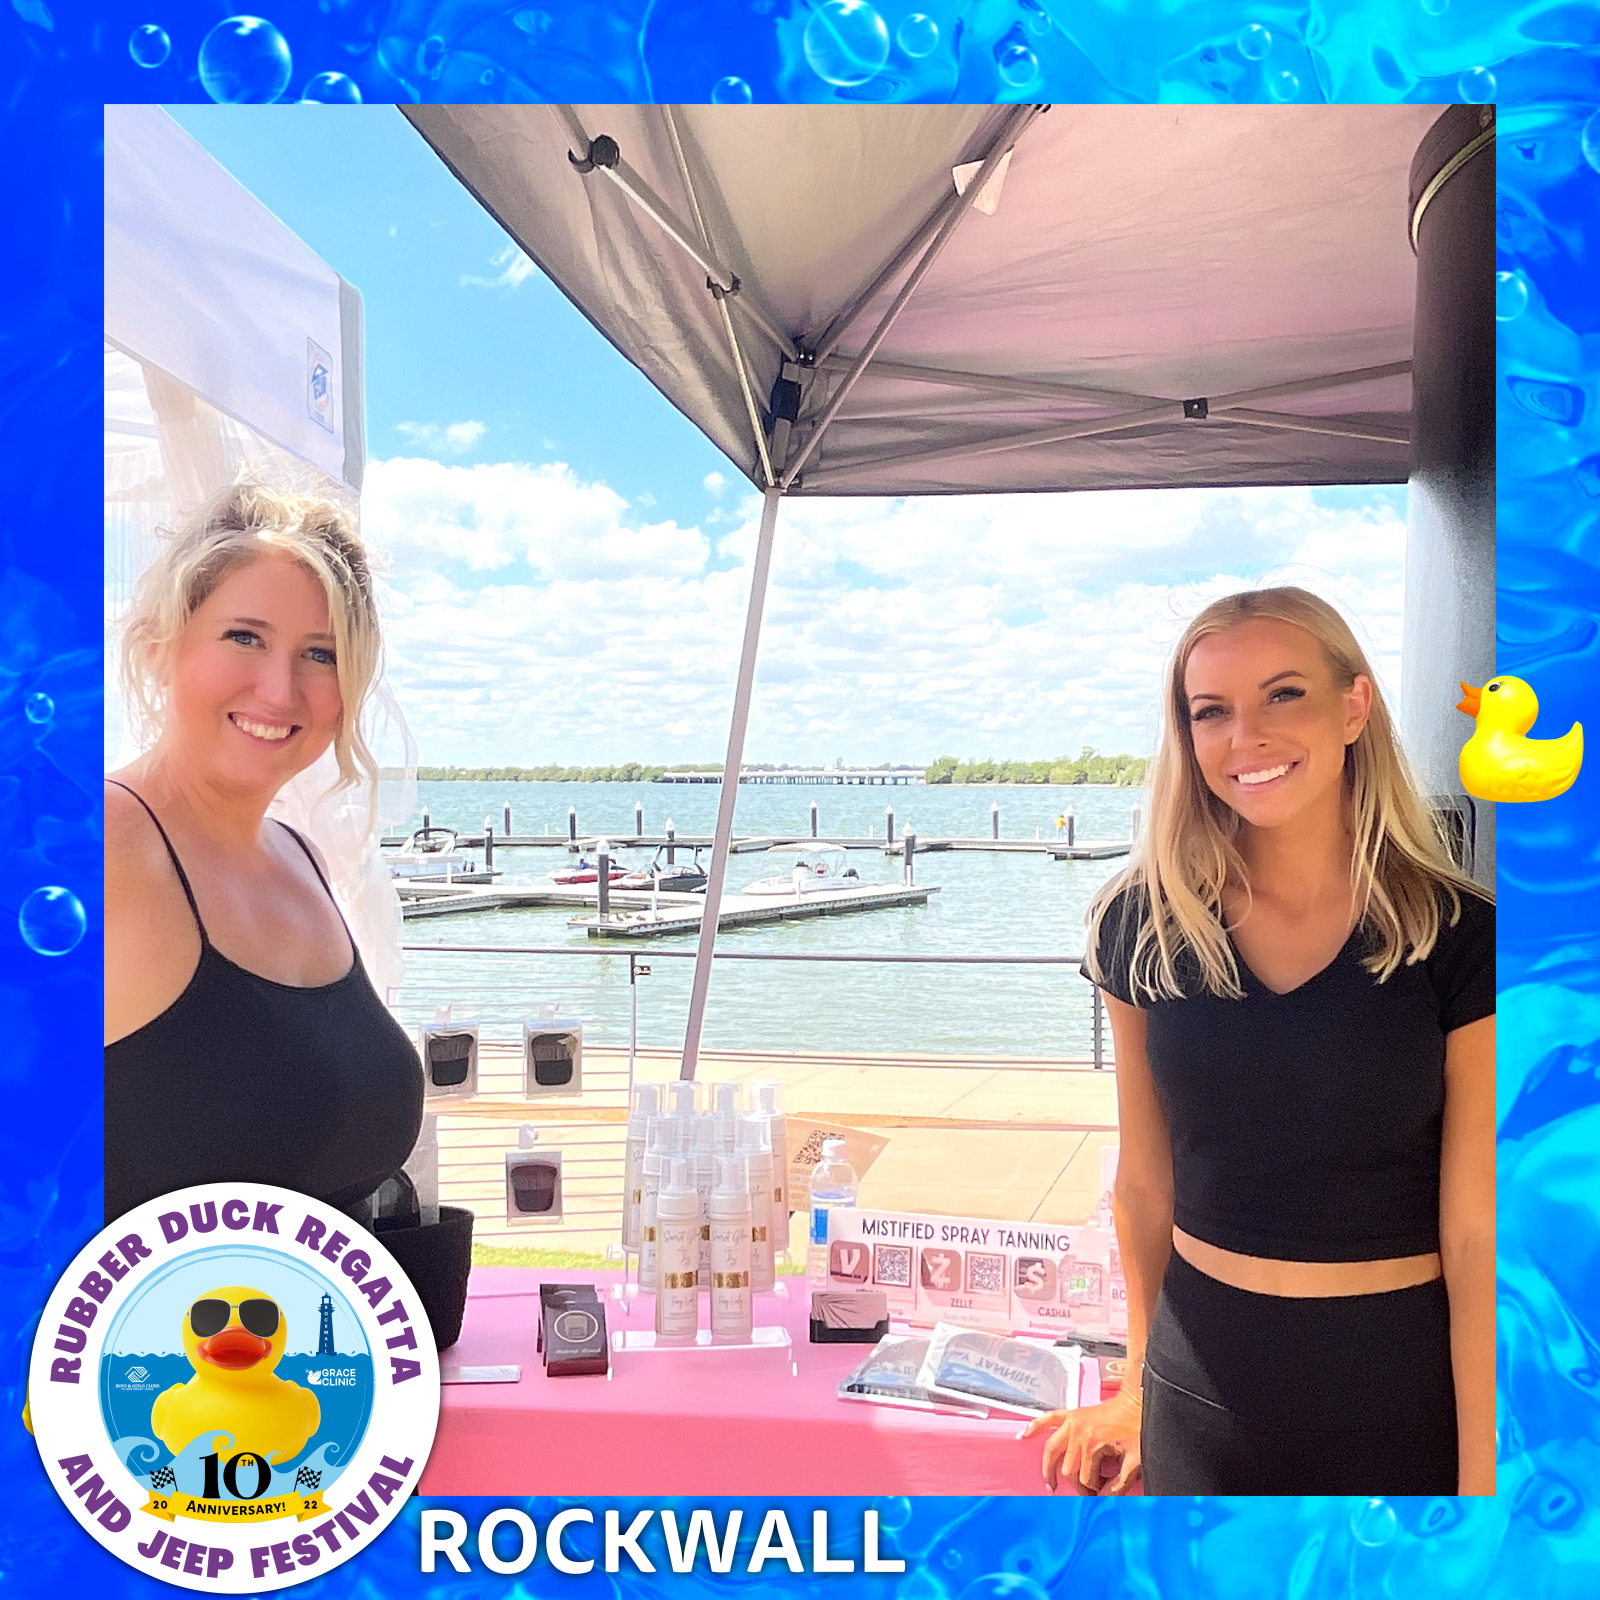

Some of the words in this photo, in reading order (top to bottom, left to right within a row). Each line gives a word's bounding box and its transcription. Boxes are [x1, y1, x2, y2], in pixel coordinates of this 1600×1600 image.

[862, 1218, 935, 1239] MISTIFIED
[941, 1225, 990, 1245] SPRAY
[997, 1229, 1070, 1251] TANNING
[950, 1298, 973, 1309] ZELLE
[943, 1312, 959, 1321] Scan
[960, 1313, 968, 1321] to
[969, 1314, 981, 1324] Pay
